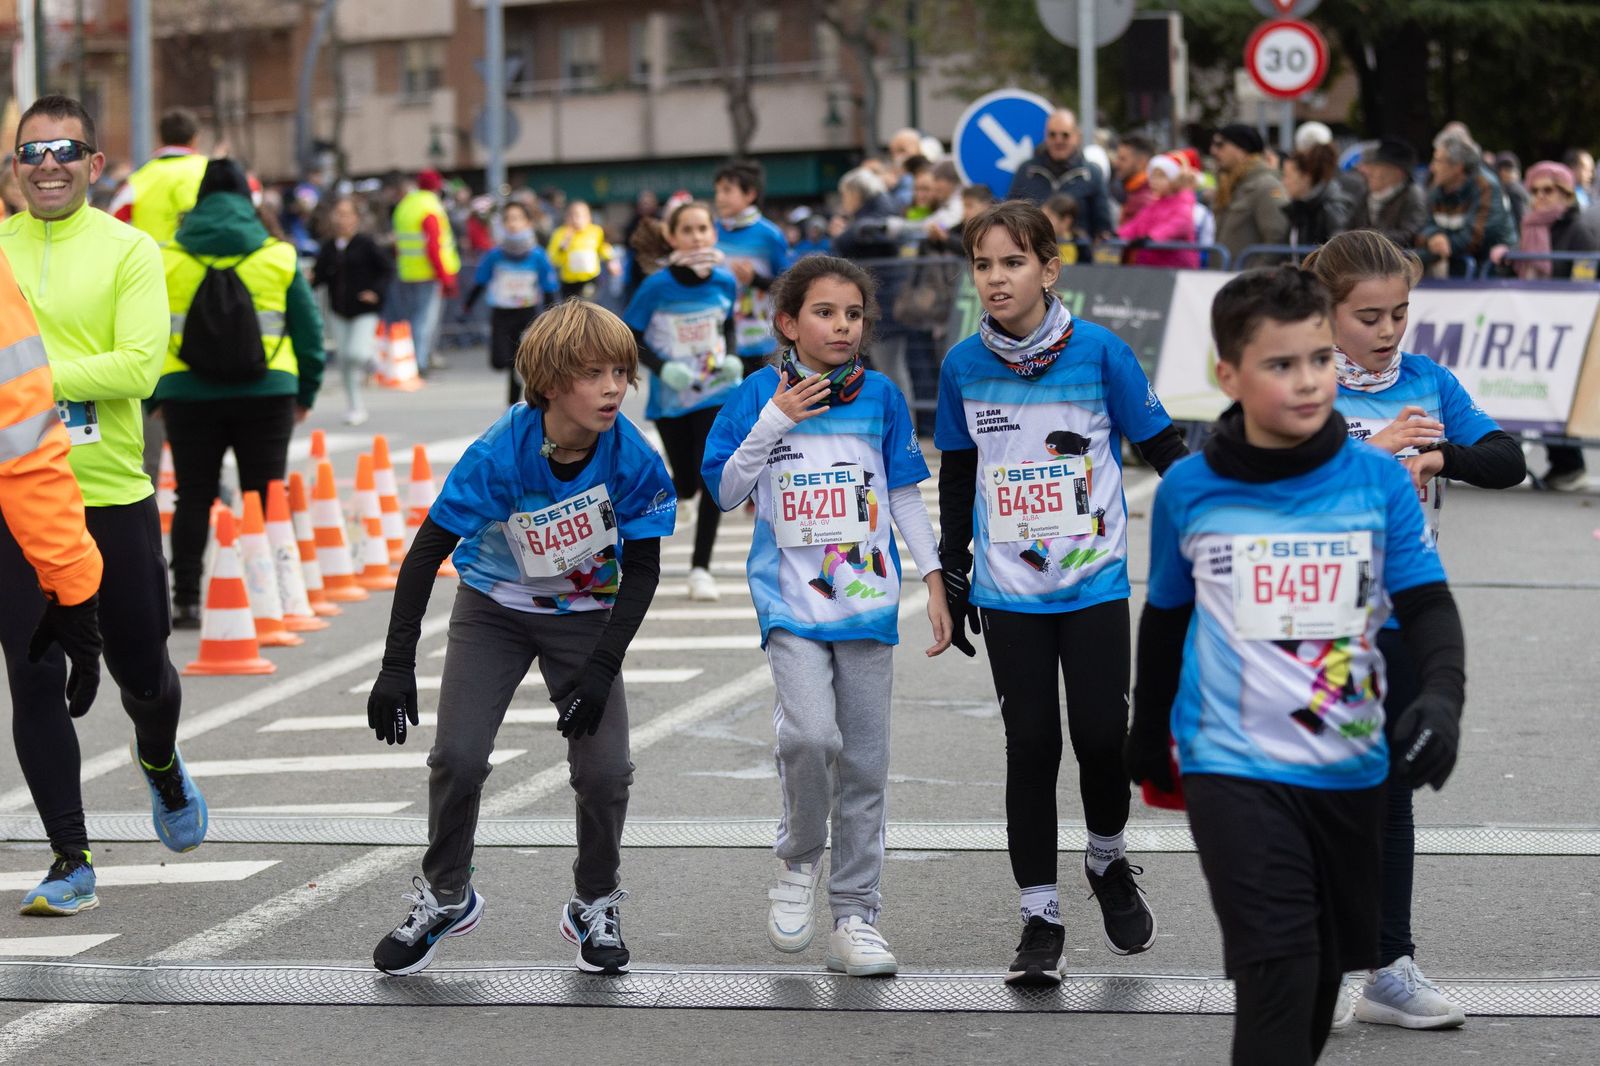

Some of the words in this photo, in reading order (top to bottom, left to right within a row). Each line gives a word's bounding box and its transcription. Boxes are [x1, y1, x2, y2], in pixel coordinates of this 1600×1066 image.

[1264, 47, 1308, 73] 30
[977, 417, 1008, 426] SILVESTRE
[977, 424, 1021, 434] SALMANTINA
[766, 453, 804, 465] ALMANTINA
[793, 470, 856, 486] SETEL
[1007, 464, 1075, 482] SETEL
[533, 495, 599, 527] SETEL
[782, 487, 846, 522] 6420
[997, 482, 1063, 517] 6435
[526, 512, 593, 556] 6498
[1272, 541, 1358, 557] SETEL
[1253, 563, 1342, 604] 6497
[396, 708, 404, 734] KIPSTA
[563, 698, 582, 722] KIPSTA
